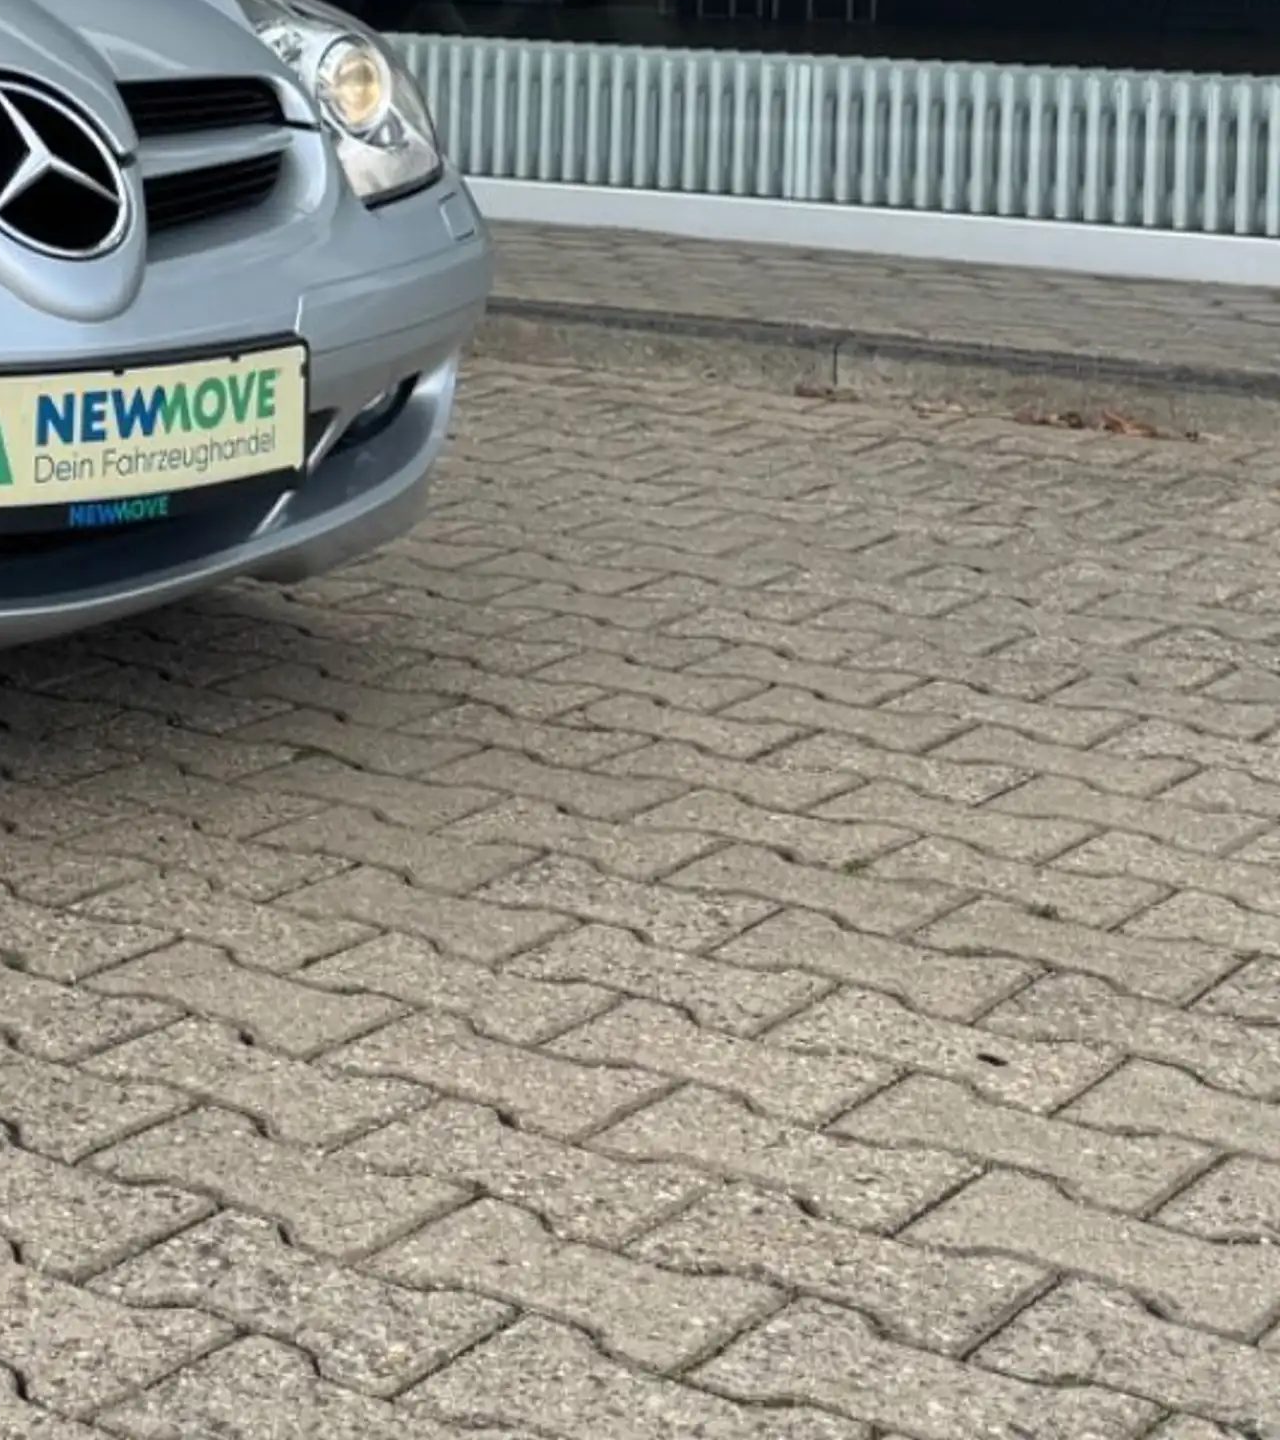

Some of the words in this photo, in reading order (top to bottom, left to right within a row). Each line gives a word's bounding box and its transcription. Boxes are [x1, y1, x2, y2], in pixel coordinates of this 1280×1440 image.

[36, 369, 276, 447] NEWMOVE
[34, 453, 95, 484] Dein
[101, 425, 276, 478] Fahrzeughandel
[69, 495, 169, 527] NEWMOVE
